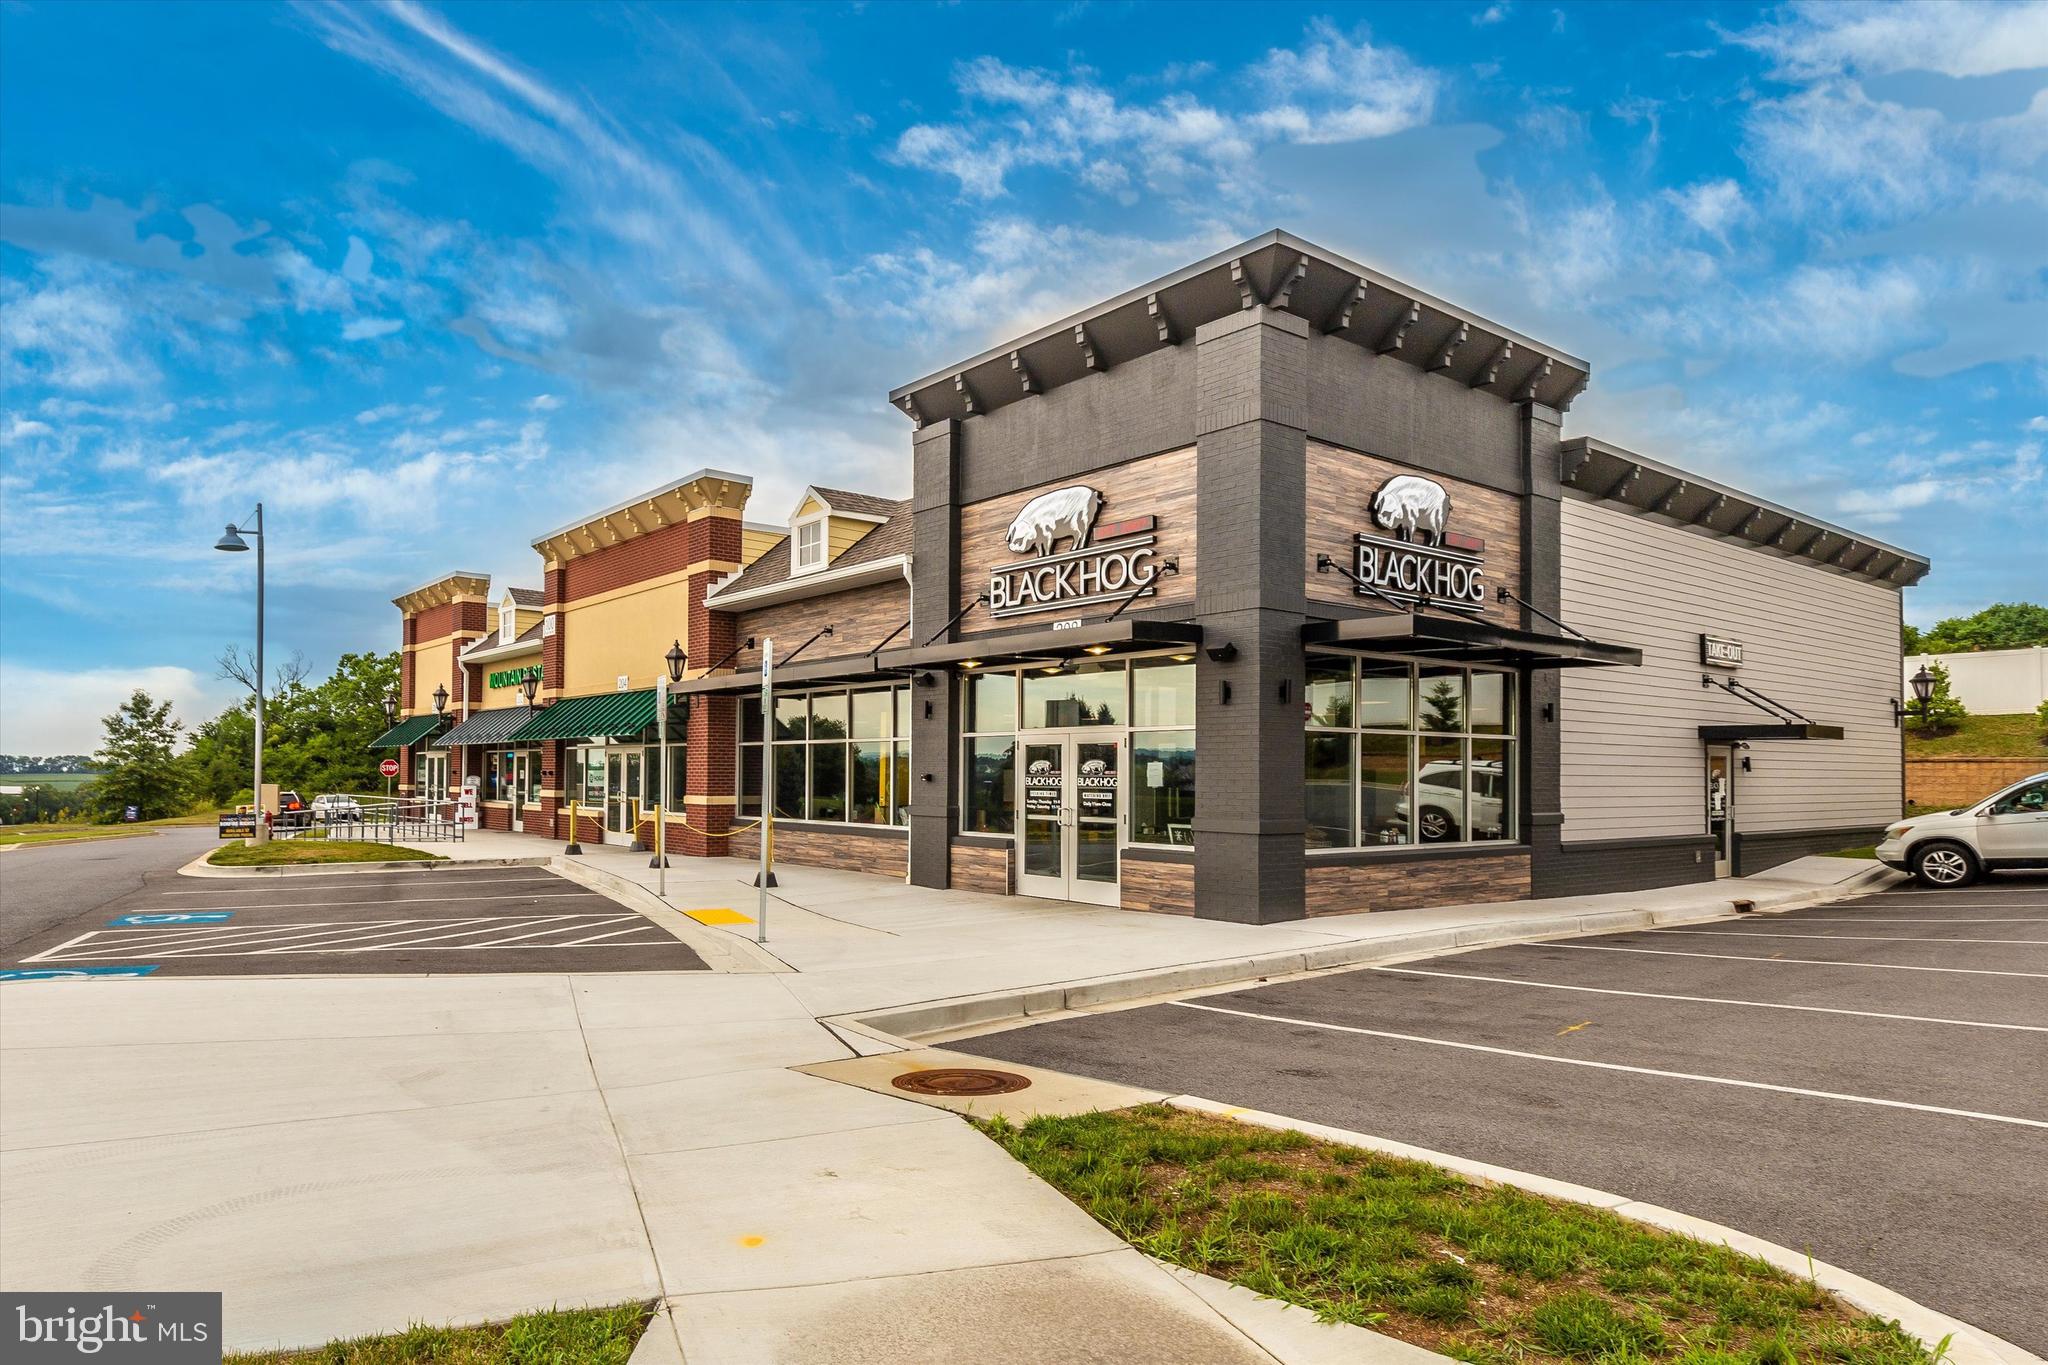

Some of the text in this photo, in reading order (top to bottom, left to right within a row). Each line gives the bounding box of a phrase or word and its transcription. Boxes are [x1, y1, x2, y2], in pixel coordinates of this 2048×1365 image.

[1706, 642, 1742, 661] TAKE-OUT
[489, 668, 522, 689] MOUNTAIN
[381, 764, 398, 772] STOP
